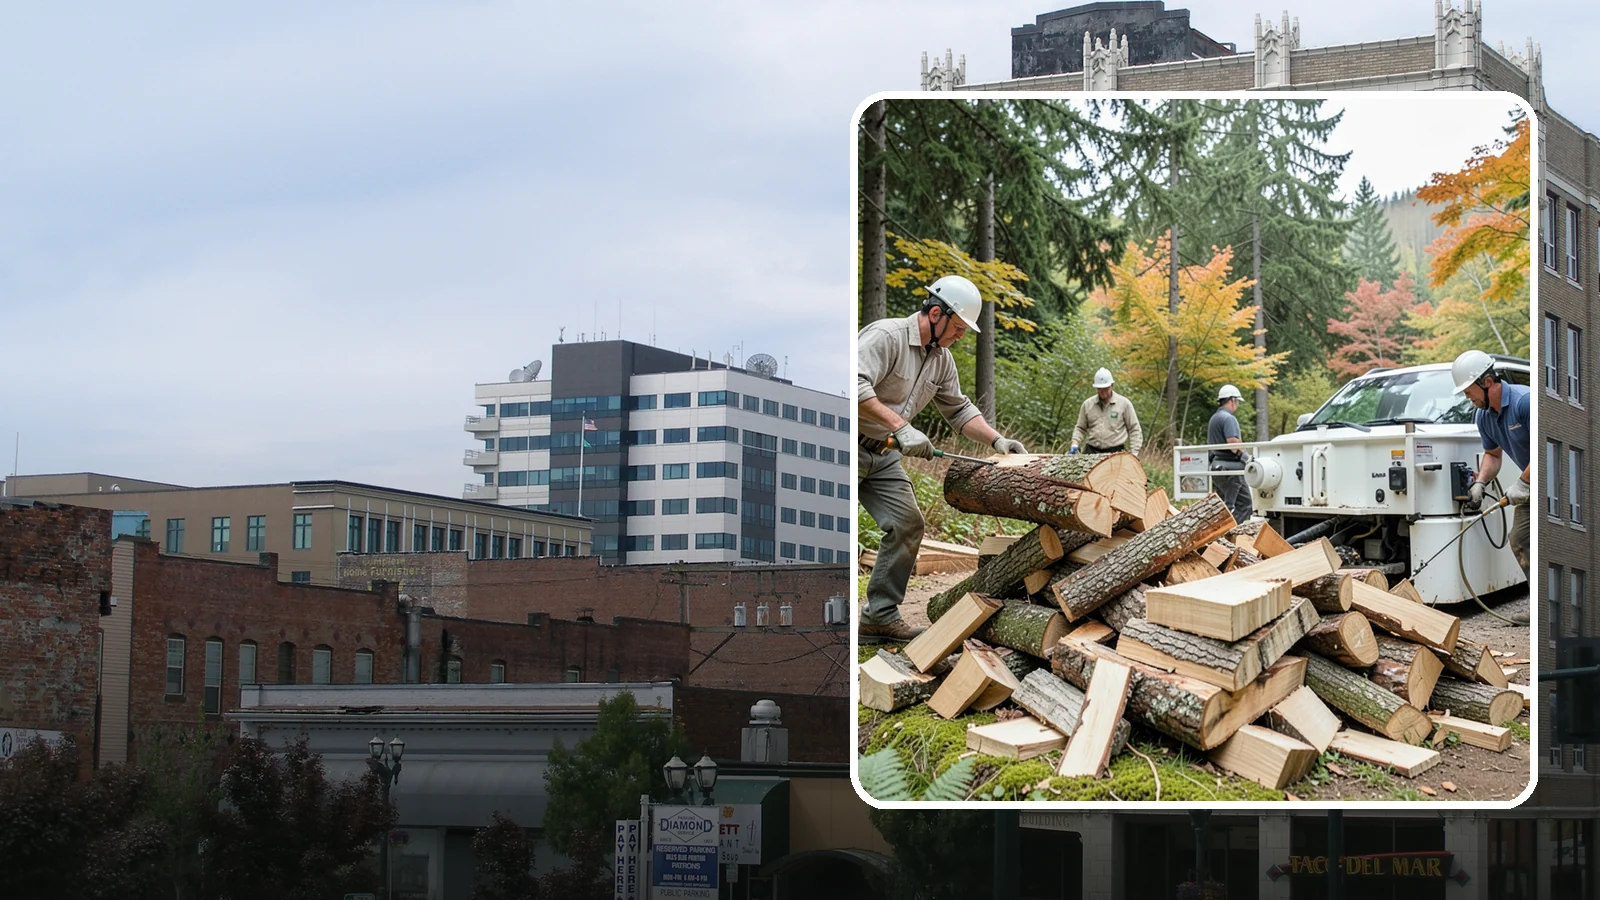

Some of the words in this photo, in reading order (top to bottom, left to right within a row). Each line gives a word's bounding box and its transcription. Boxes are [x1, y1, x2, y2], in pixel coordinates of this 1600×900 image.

[343, 567, 367, 577] Home
[370, 566, 427, 576] Furnishers
[660, 818, 713, 832] DIAMOND
[1022, 815, 1069, 828] BUILDING
[617, 825, 625, 852] PAY
[628, 824, 636, 852] PAY
[656, 845, 688, 853] RESERVED
[689, 846, 716, 854] PARKING
[617, 856, 625, 893] HERE
[627, 856, 636, 893] HERE
[1346, 856, 1384, 875] DEL
[1392, 857, 1442, 876] MAR
[660, 888, 682, 897] PUBLIC
[684, 889, 710, 898] PARKING
